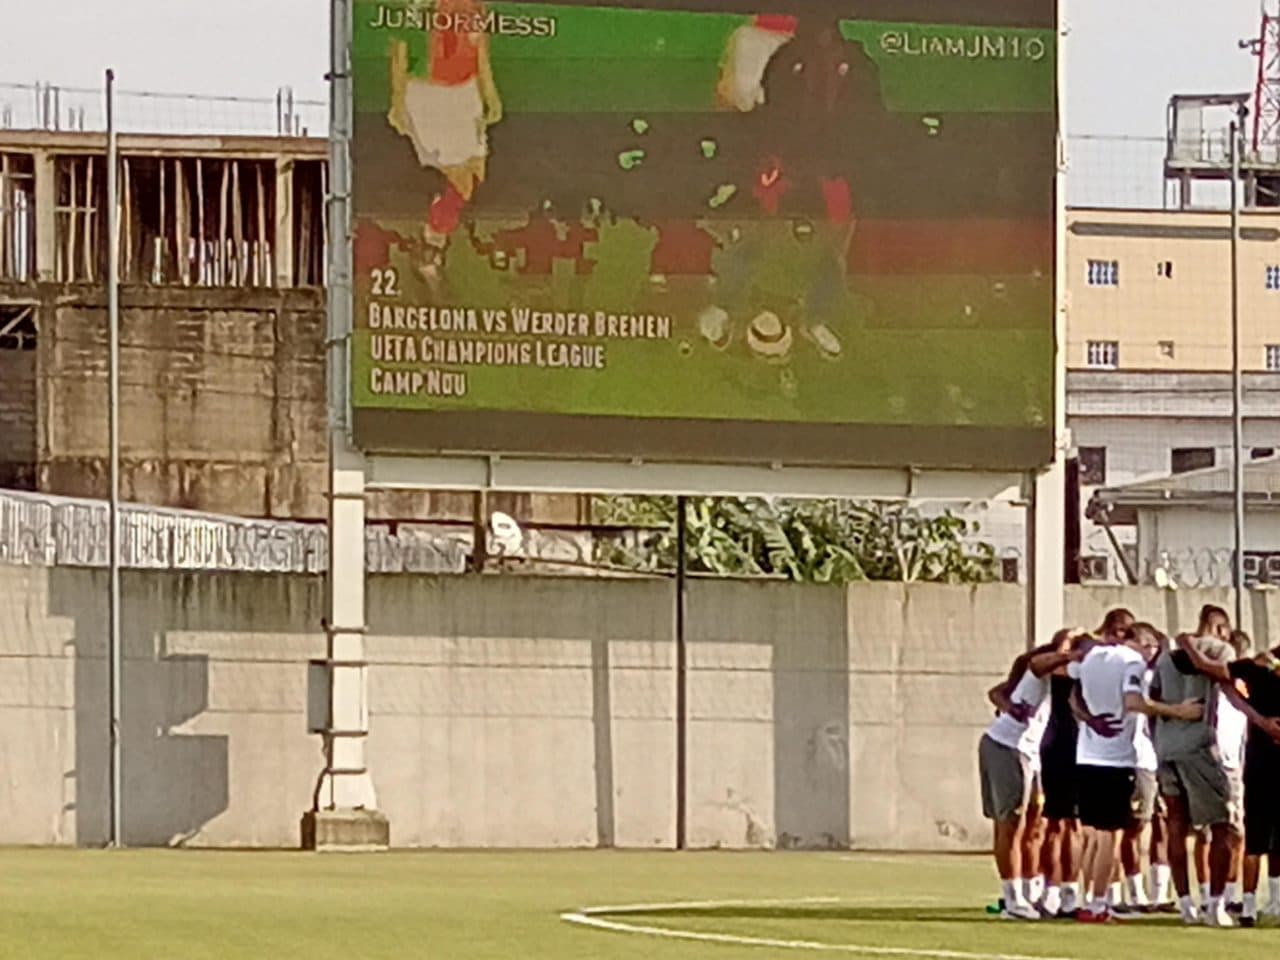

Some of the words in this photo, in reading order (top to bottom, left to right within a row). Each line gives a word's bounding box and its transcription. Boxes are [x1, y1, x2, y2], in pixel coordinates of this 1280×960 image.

[369, 302, 477, 331] BARCELONA
[482, 310, 507, 333] VS
[512, 308, 589, 337] WERDER
[595, 311, 670, 339] BREMEN
[421, 335, 531, 365] CHAMPIONS
[536, 341, 604, 368] LEAGUE
[371, 367, 422, 394] CAMP
[427, 370, 466, 395] NOU
